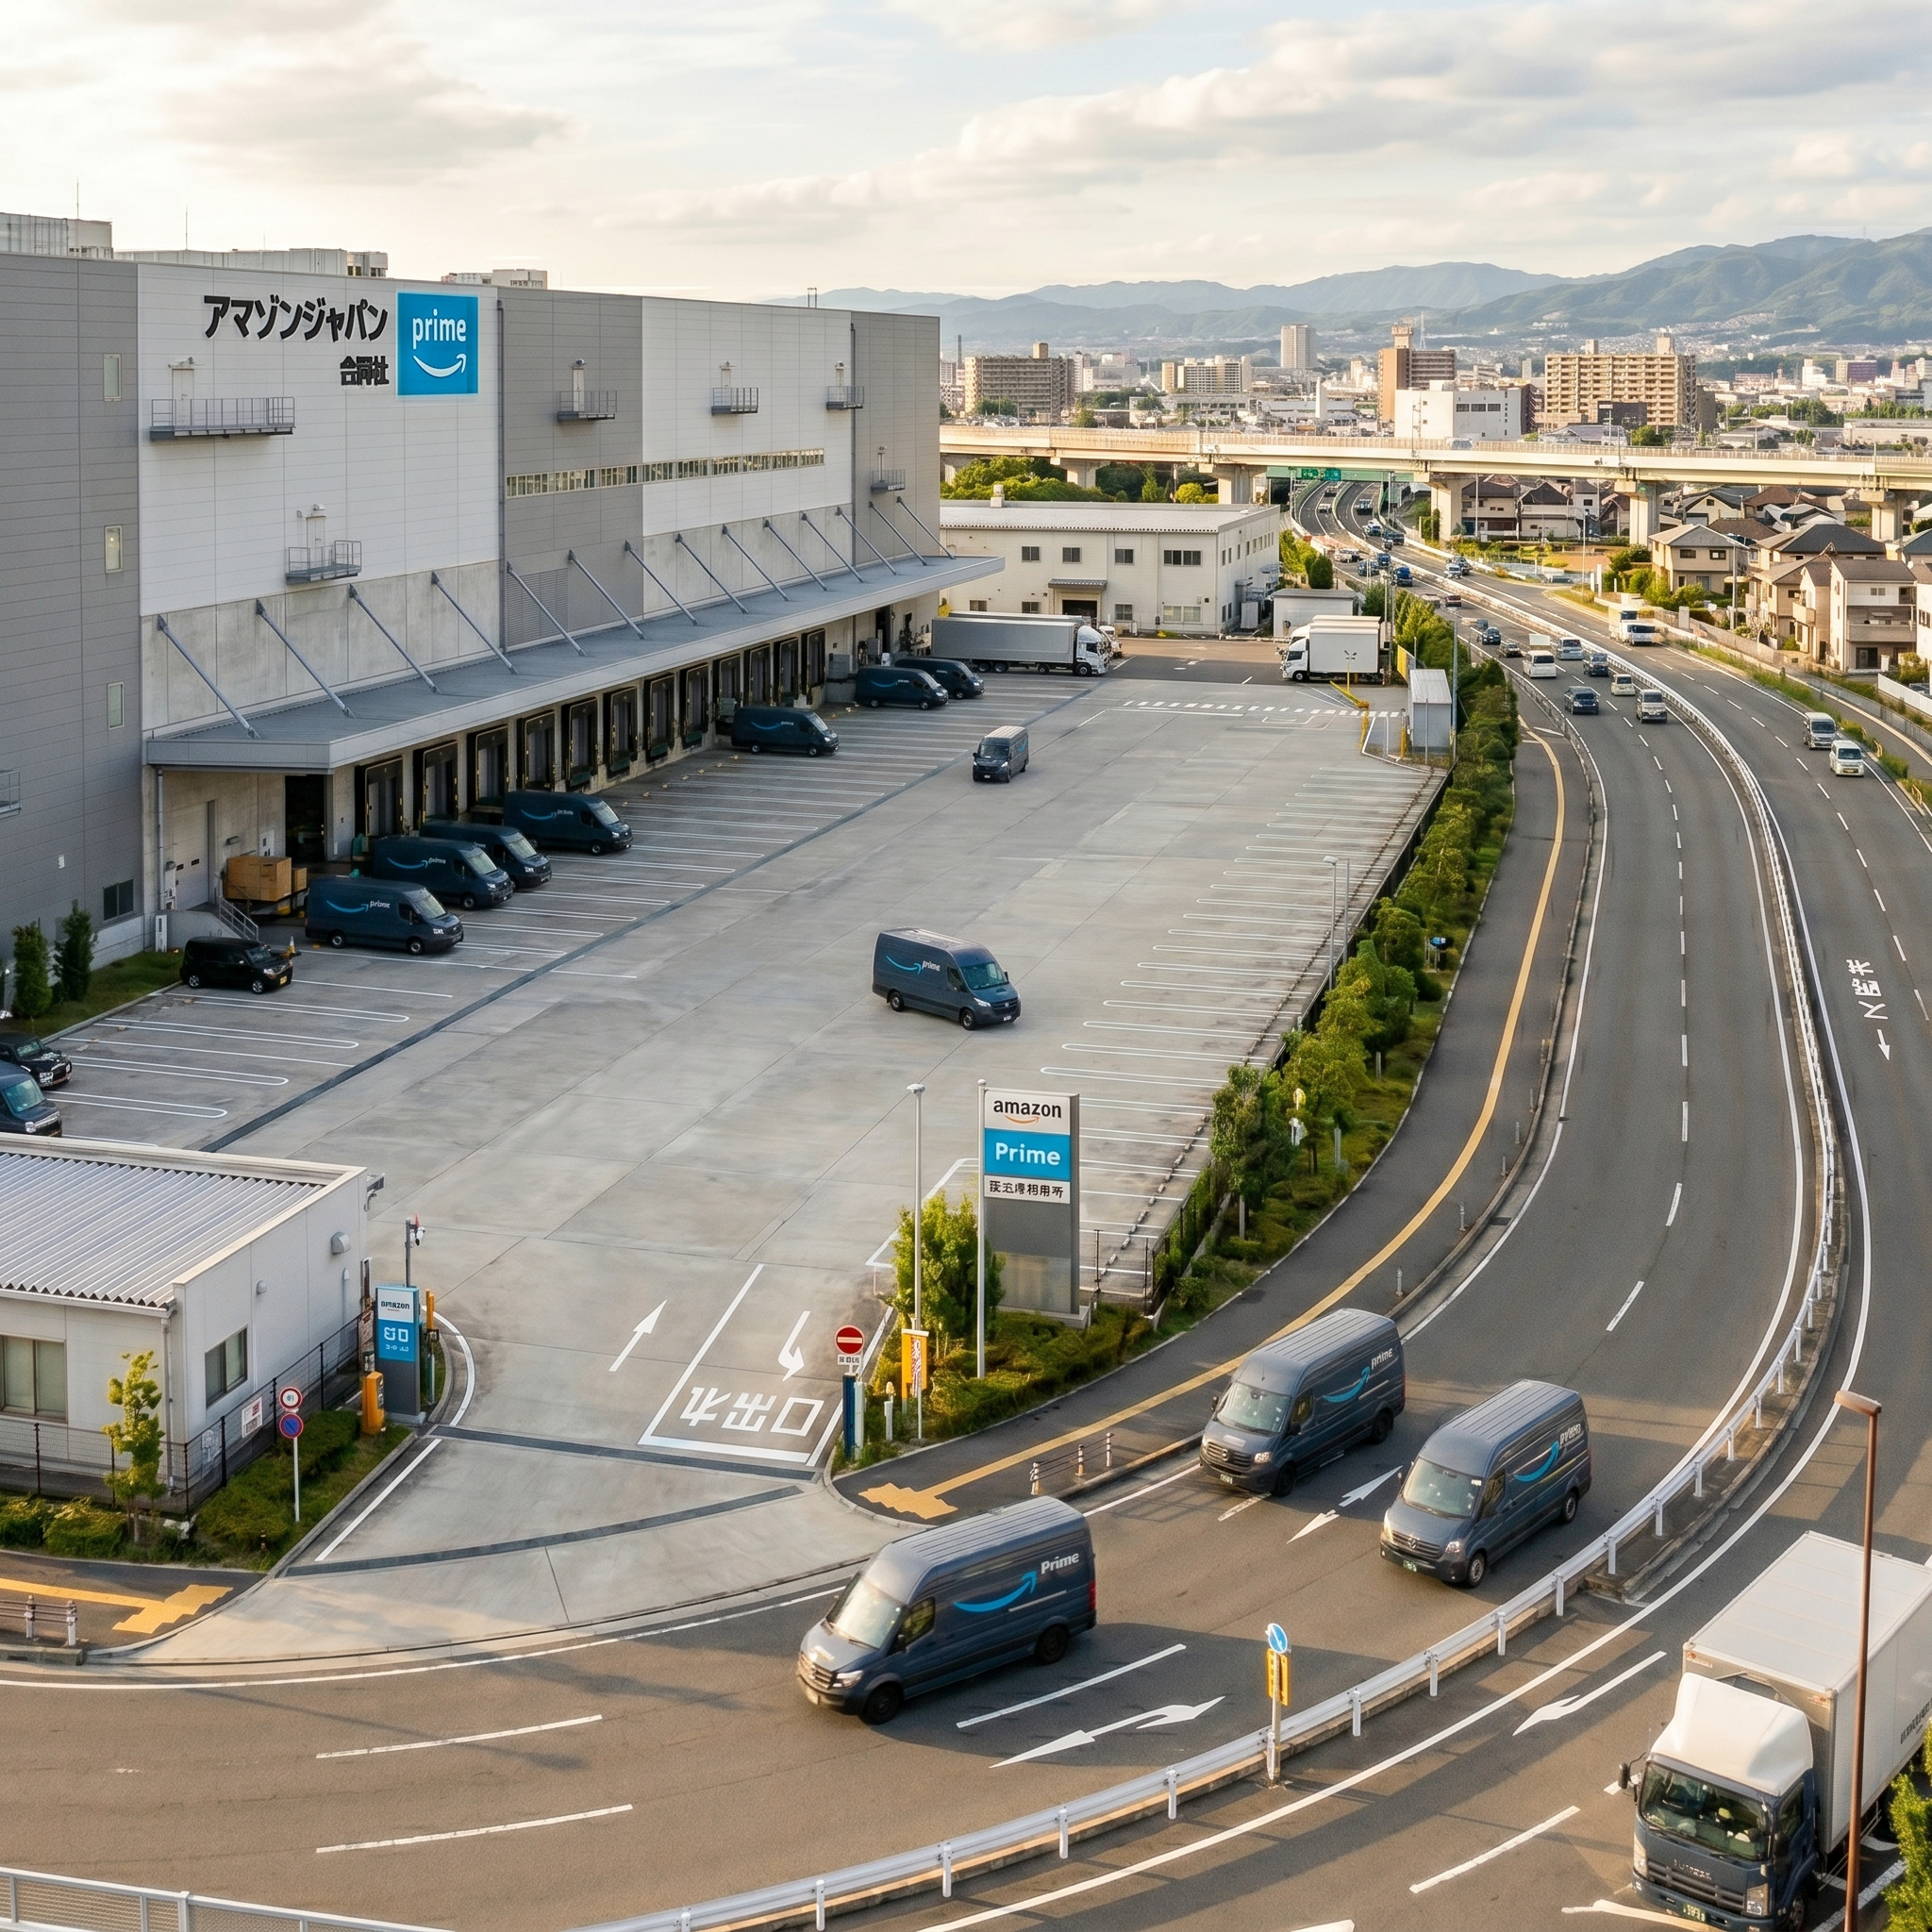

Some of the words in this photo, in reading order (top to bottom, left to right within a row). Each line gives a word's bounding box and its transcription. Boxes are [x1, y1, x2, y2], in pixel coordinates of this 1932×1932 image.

[203, 294, 389, 342] アマゾンジャパン
[412, 308, 467, 350] prime
[993, 1099, 1062, 1119] amazon
[995, 1141, 1061, 1166] Prime
